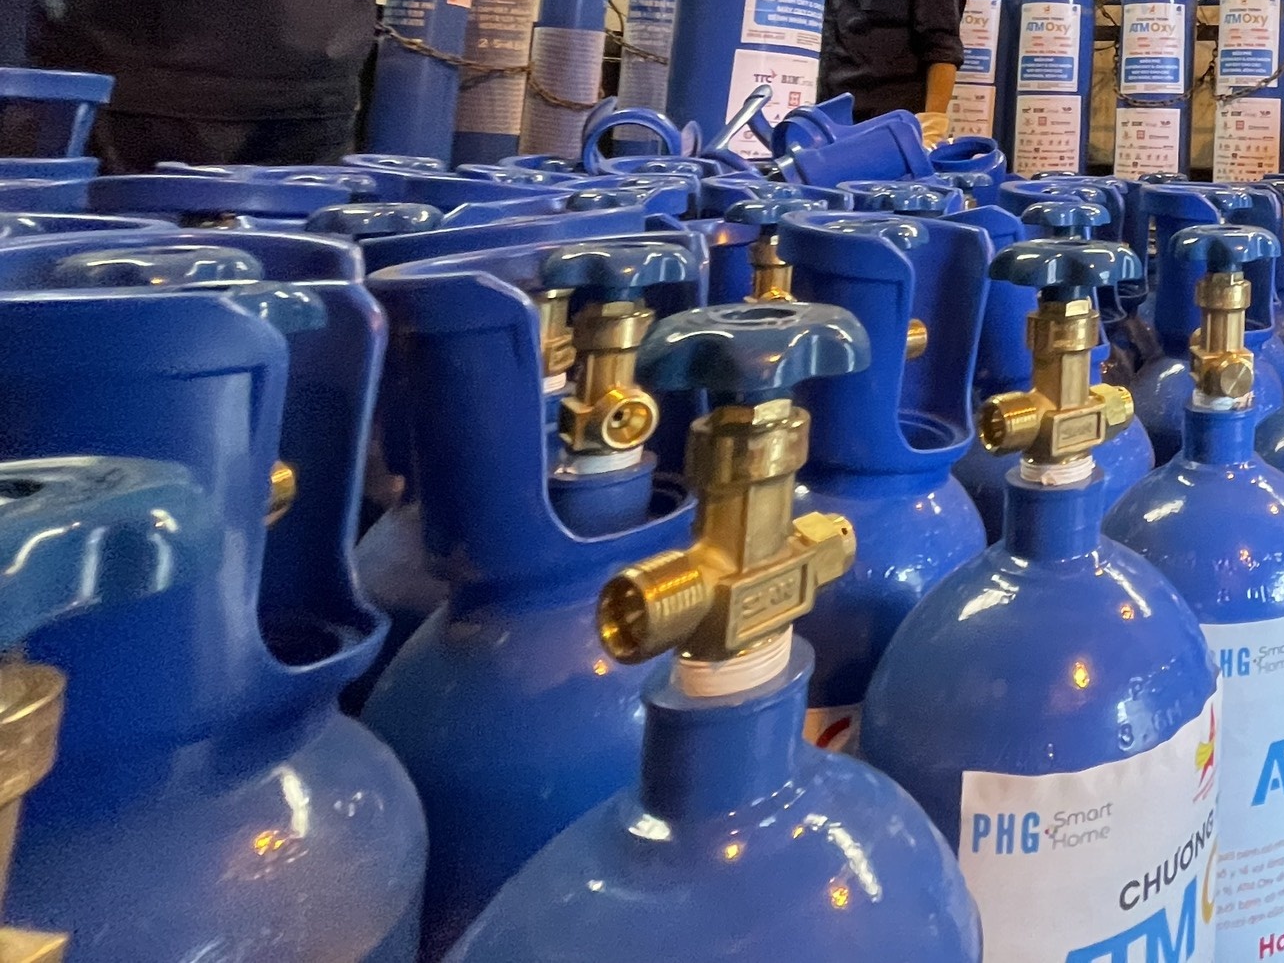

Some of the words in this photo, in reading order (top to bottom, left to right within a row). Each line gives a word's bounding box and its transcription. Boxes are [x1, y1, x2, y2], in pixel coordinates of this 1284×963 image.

[965, 15, 988, 27] Oxy
[1046, 22, 1071, 35] Oxy
[1151, 22, 1175, 35] Oxy
[1243, 13, 1268, 27] Oxy
[1219, 647, 1250, 678] HG
[1053, 802, 1113, 828] Smart
[972, 812, 1040, 854] PHG
[1051, 826, 1111, 850] Home
